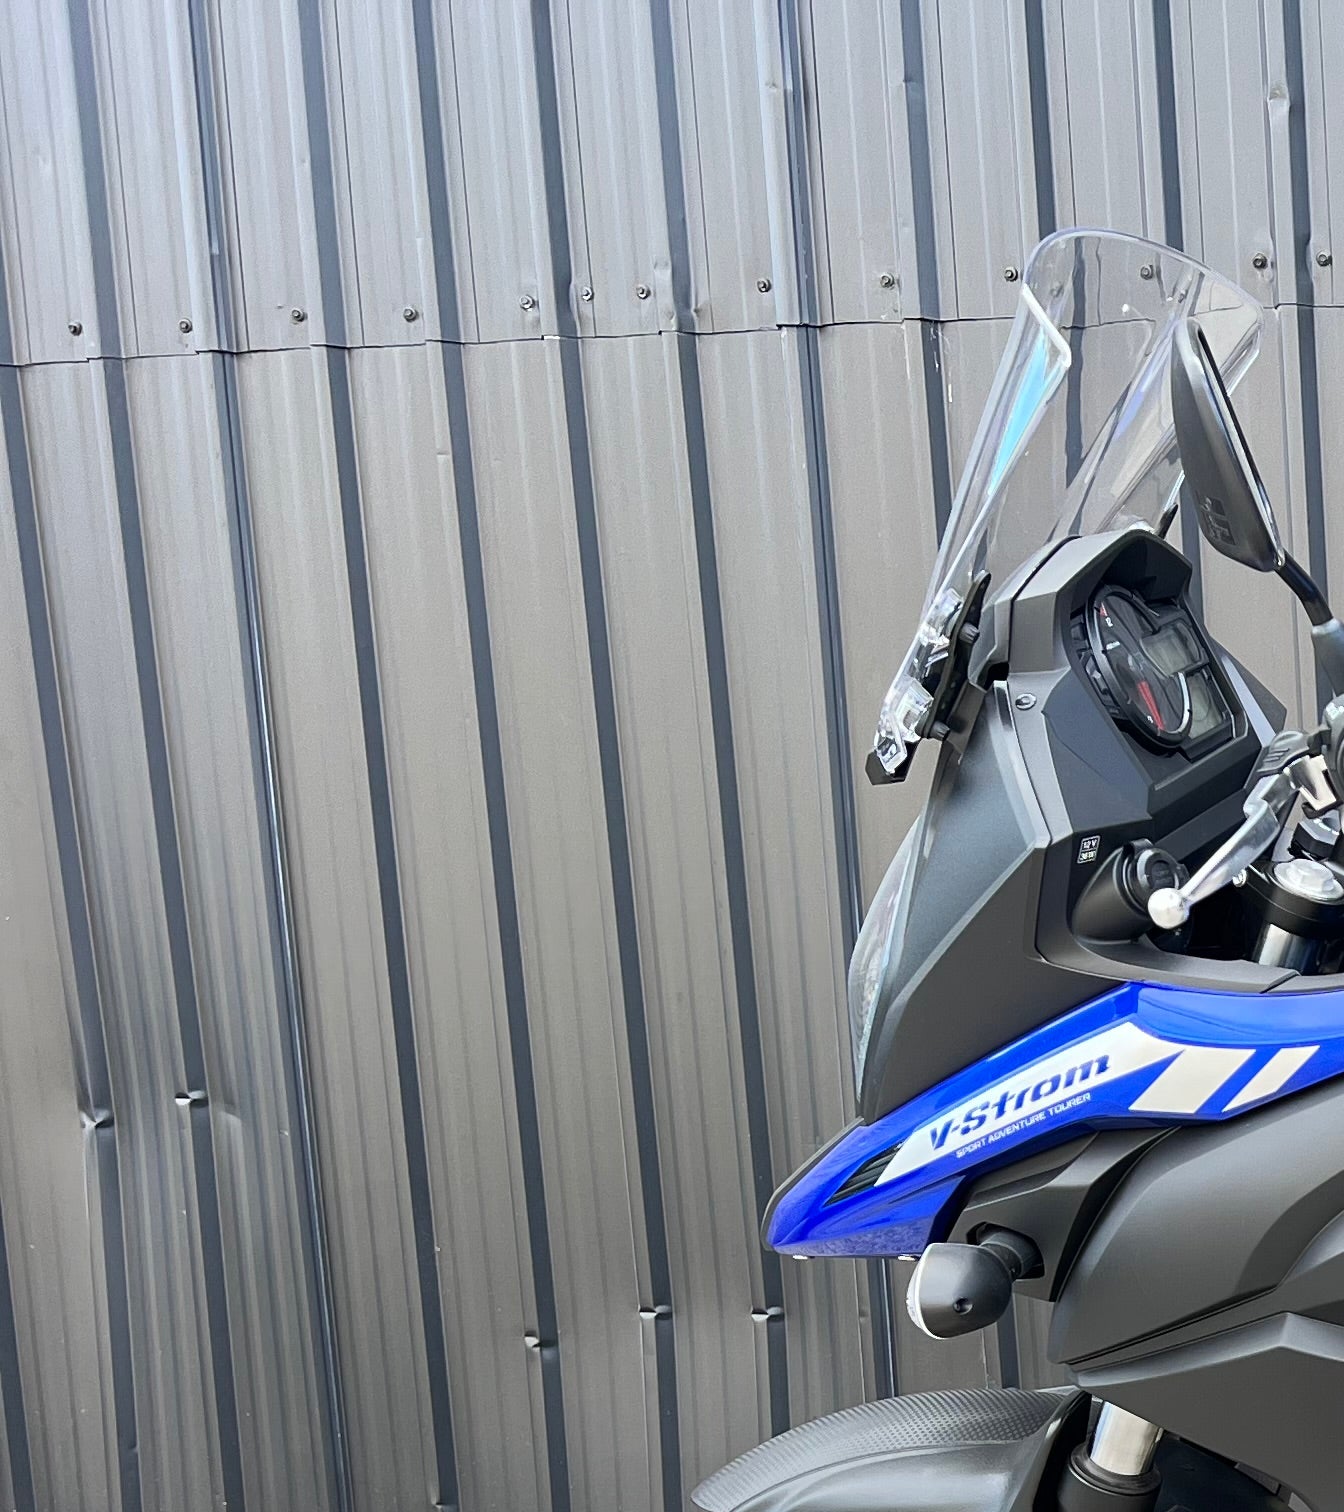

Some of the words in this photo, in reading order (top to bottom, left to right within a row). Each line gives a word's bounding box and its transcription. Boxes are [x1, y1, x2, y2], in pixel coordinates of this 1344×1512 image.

[930, 1054, 1110, 1150] V-Strom
[956, 1137, 986, 1158] SPORT
[988, 1111, 1046, 1143] ADVENTURE
[1048, 1092, 1091, 1115] TOURER
